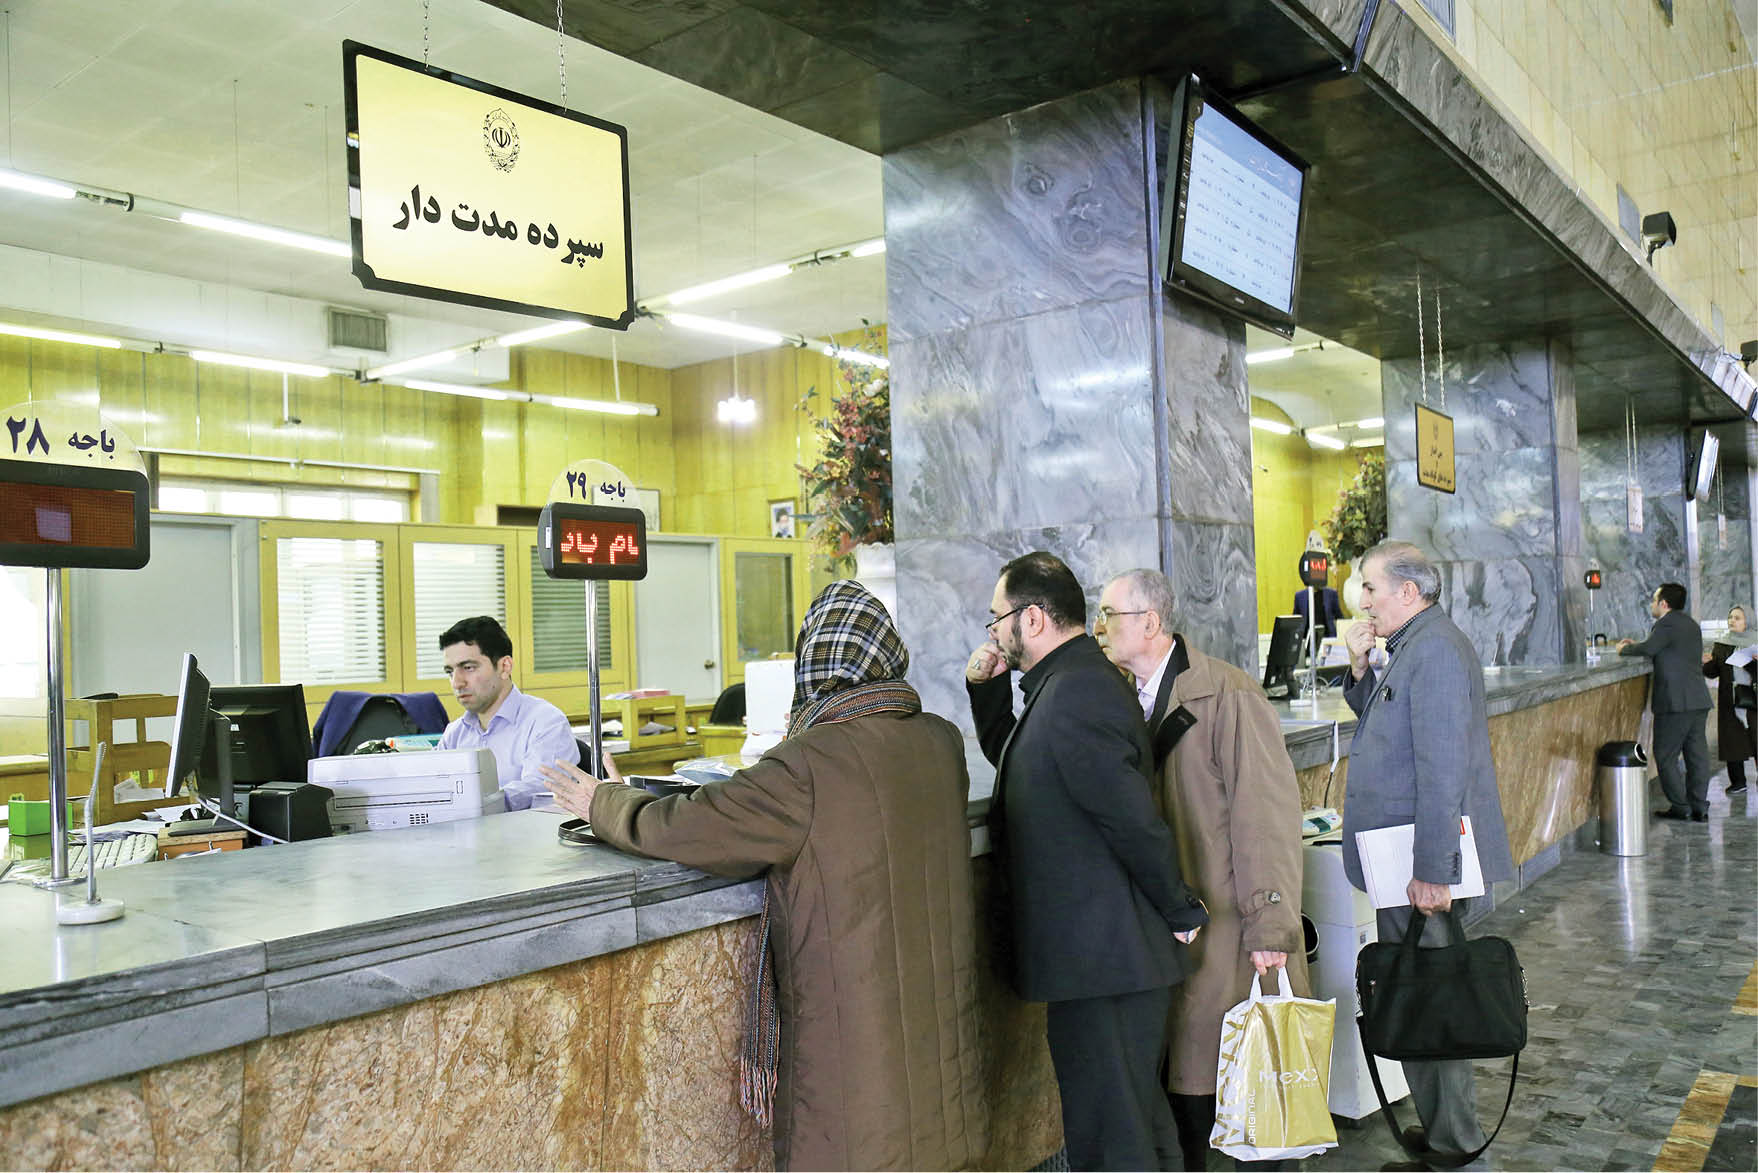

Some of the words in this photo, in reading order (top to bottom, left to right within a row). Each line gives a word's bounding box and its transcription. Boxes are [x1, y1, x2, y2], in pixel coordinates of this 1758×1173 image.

[392, 184, 442, 230] دار
[451, 202, 518, 241] مدت
[527, 221, 604, 269] سپرده
[6, 415, 50, 456] ۲۸
[67, 429, 116, 460] باجه
[566, 471, 587, 500] ۲۹
[600, 480, 626, 503] باجه
